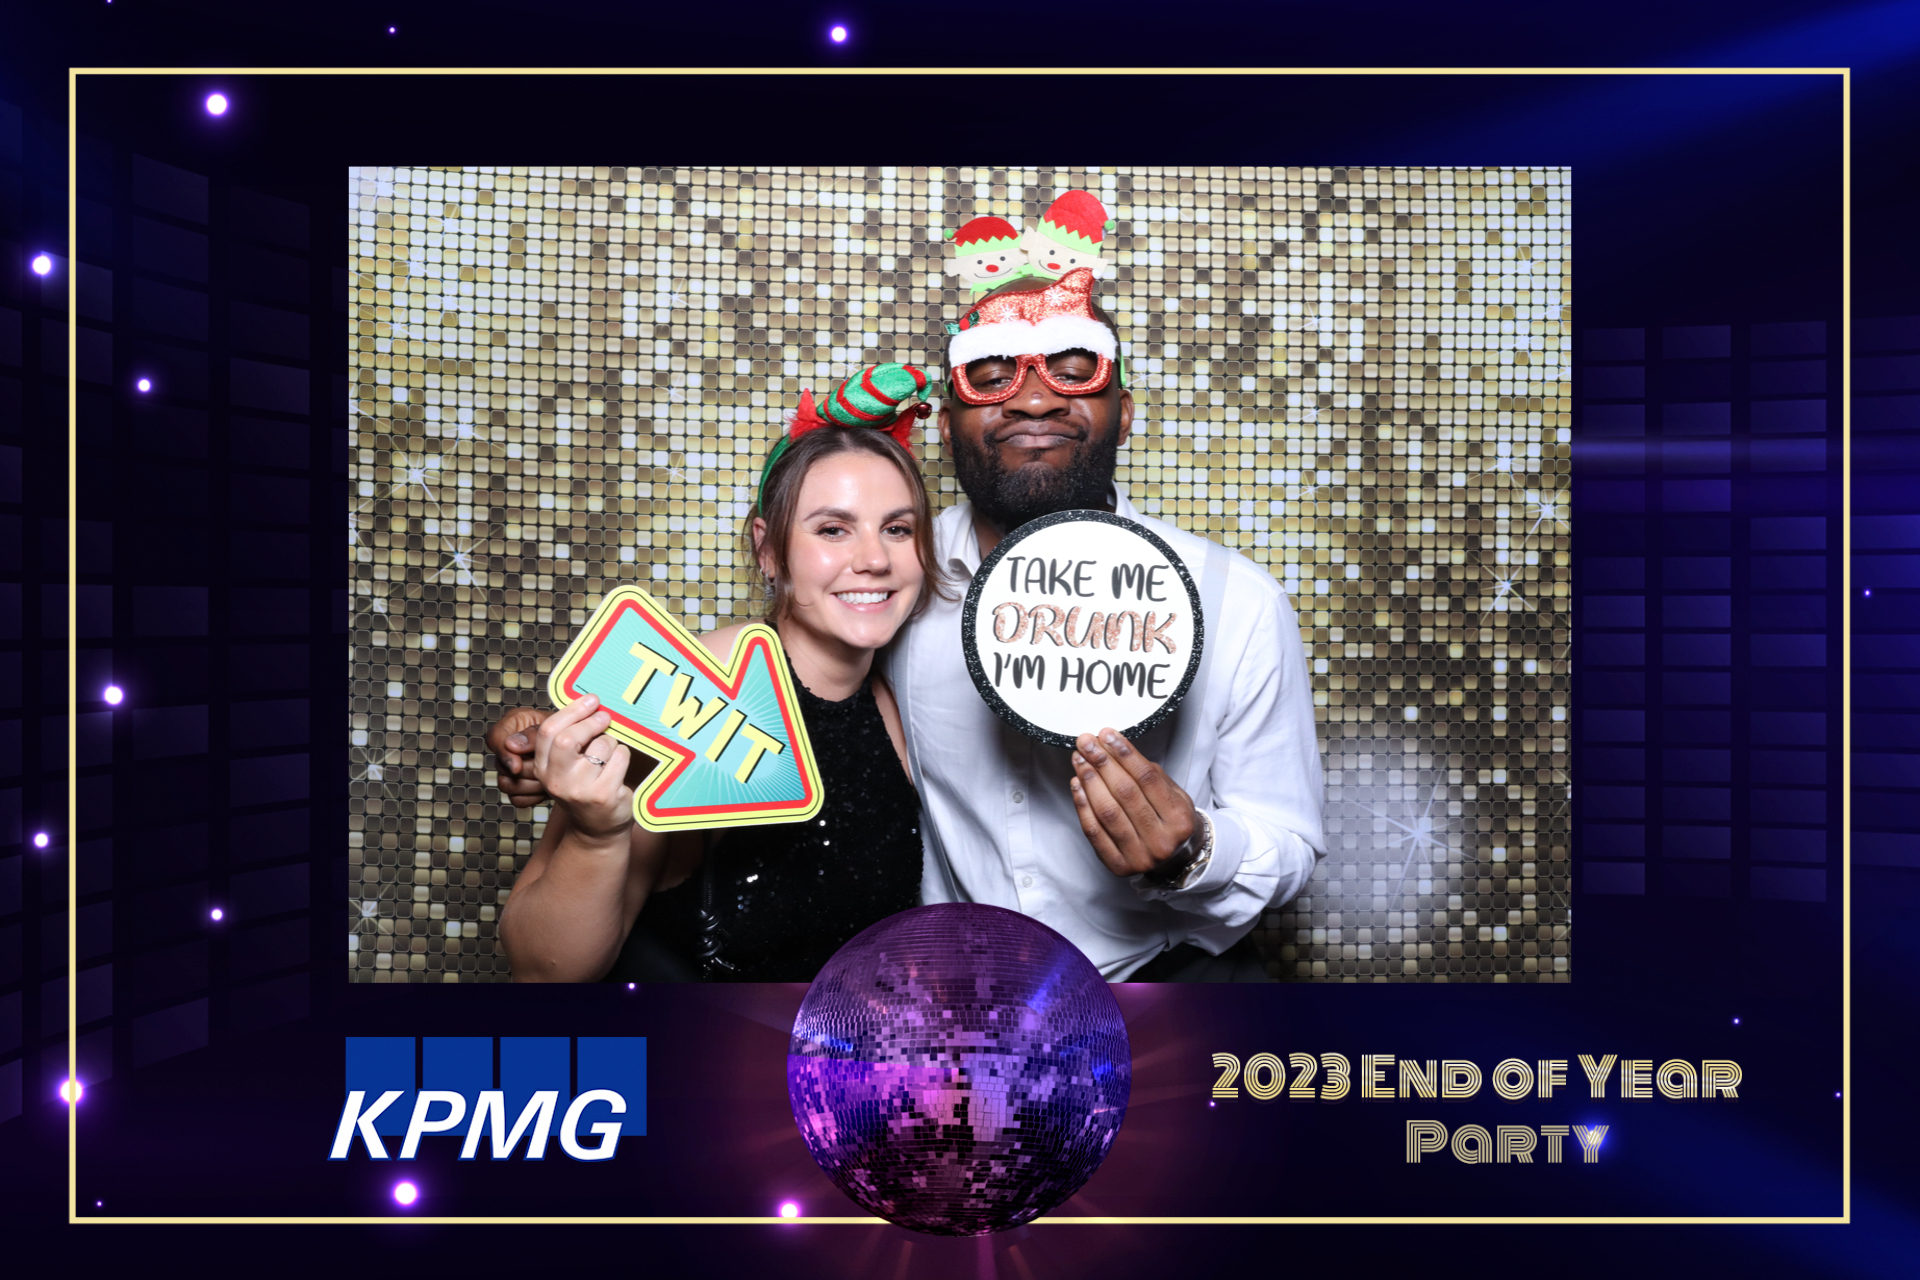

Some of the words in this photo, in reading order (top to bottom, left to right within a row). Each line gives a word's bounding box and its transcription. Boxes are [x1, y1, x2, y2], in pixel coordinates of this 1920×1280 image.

[1007, 556, 1097, 597] TAKE
[1111, 563, 1169, 602] ME
[992, 601, 1177, 654] DRUNK
[994, 652, 1045, 690] I'M
[1060, 656, 1171, 699] HOME
[621, 641, 786, 784] TWIT
